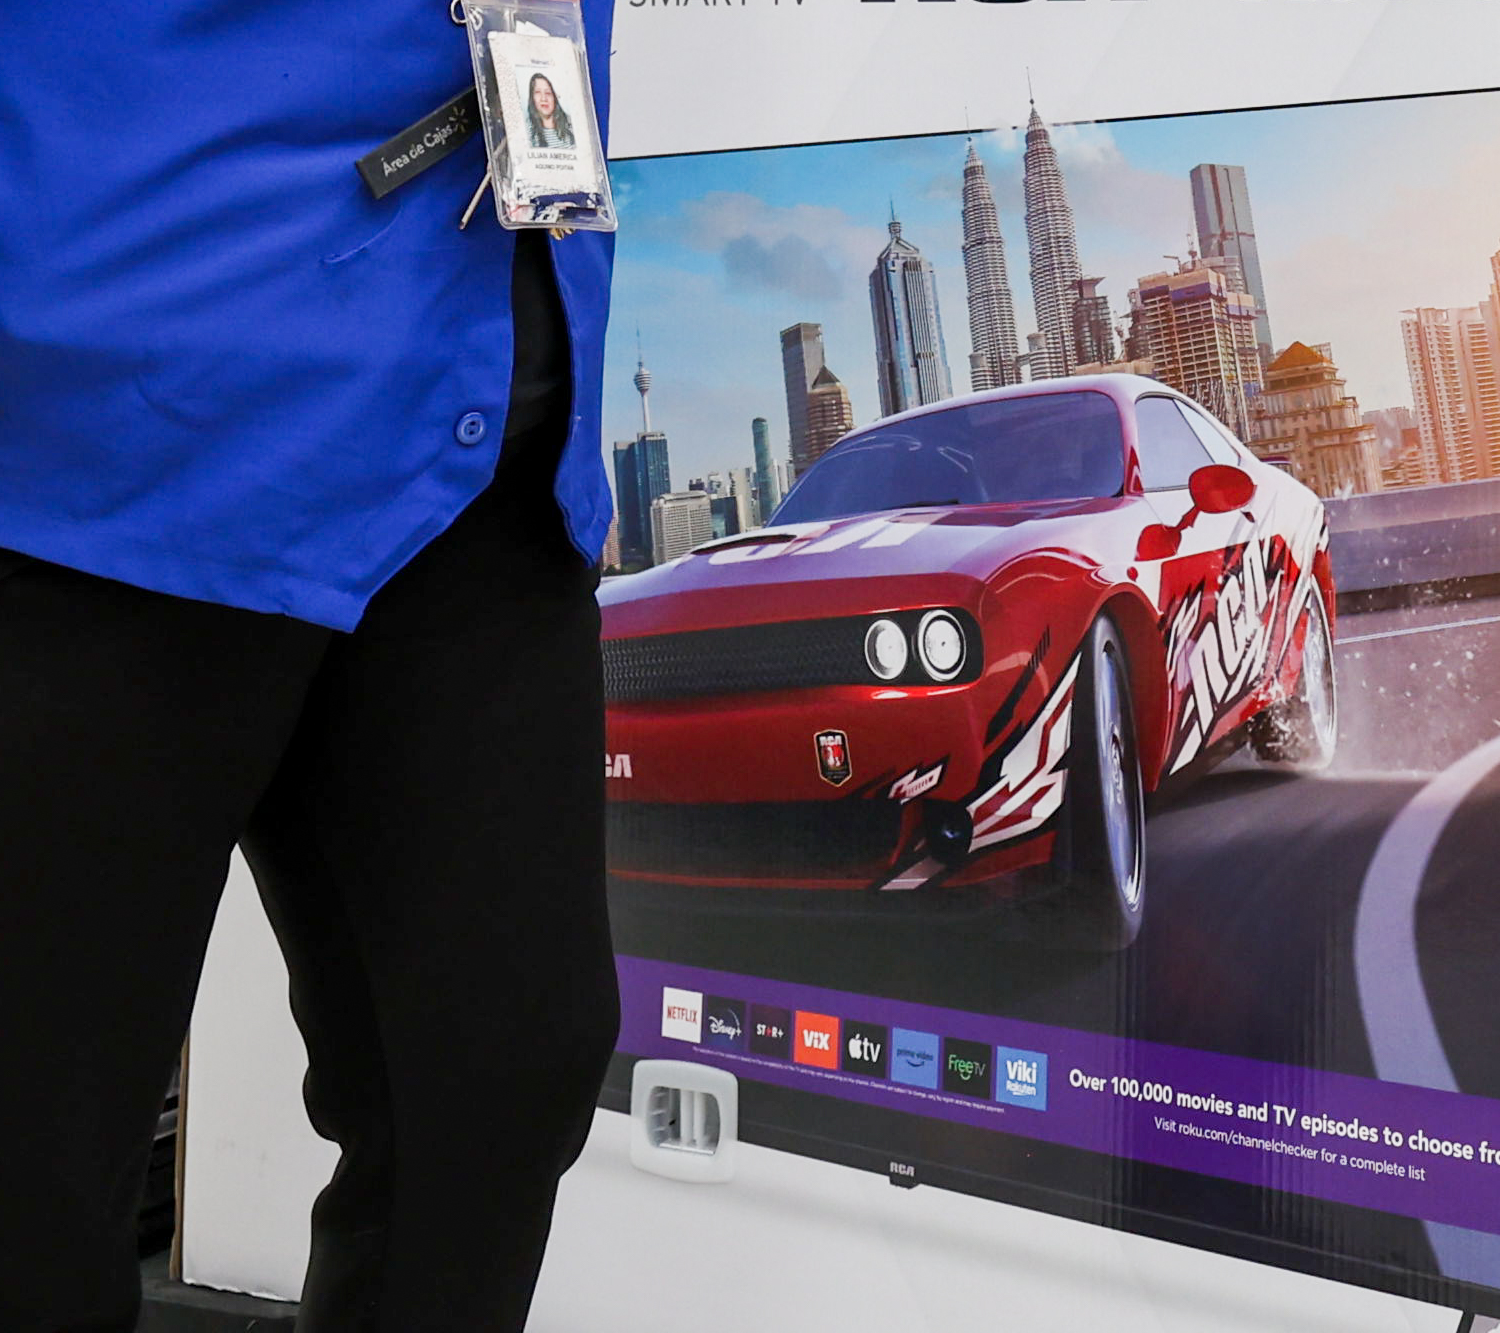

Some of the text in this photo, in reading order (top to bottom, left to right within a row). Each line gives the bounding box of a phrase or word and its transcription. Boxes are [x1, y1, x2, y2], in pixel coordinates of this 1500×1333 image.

[382, 122, 453, 177] Área de Cajas
[667, 1006, 697, 1025] NETFLIX
[862, 1039, 881, 1063] tv
[1006, 1060, 1037, 1083] Viki
[1006, 1081, 1036, 1096] Rakuten
[1069, 1069, 1107, 1093] Over
[1111, 1077, 1173, 1105] 100,000
[1177, 1090, 1233, 1117] movies
[1237, 1101, 1268, 1123] and
[1273, 1106, 1296, 1127] TV
[1301, 1114, 1379, 1142] episodes
[1383, 1126, 1403, 1147] to
[1408, 1132, 1474, 1161] choose
[1154, 1116, 1425, 1181] Visit roku.com/channelchecker for a complete list
[890, 1161, 915, 1176] RCA
